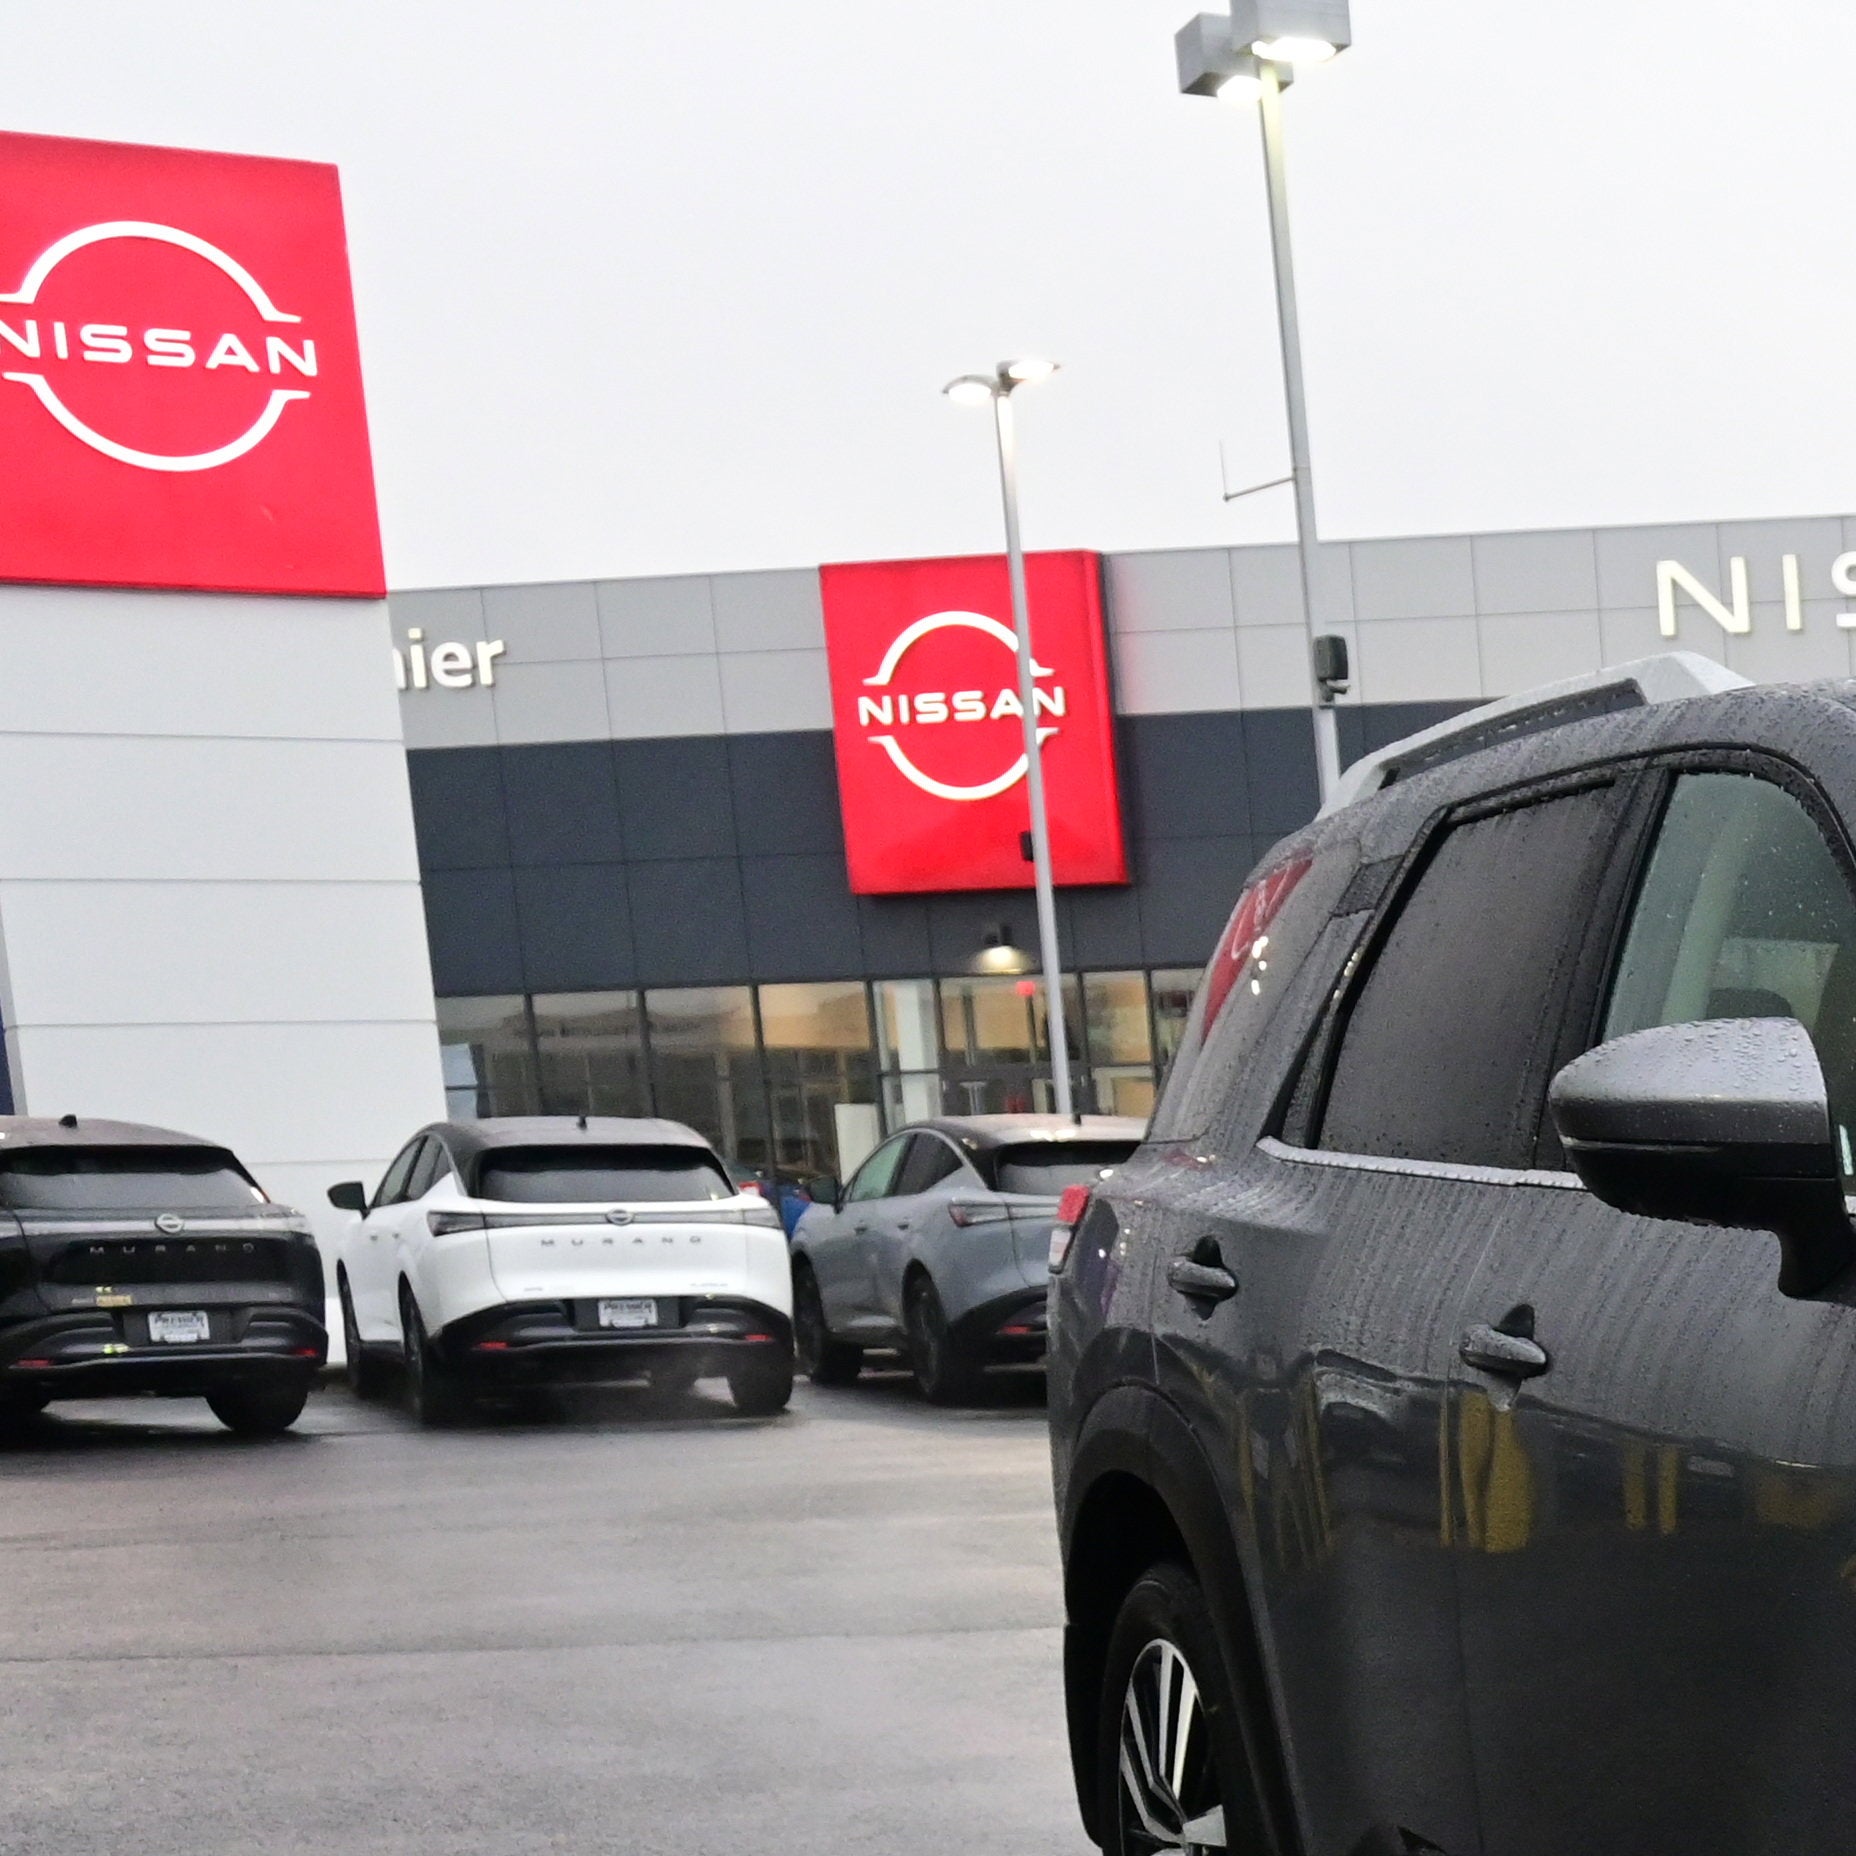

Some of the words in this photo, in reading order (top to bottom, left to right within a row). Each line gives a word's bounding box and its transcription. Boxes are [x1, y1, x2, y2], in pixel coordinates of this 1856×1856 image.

[0, 319, 318, 377] NISSAN
[858, 686, 1066, 726] NISSAN
[89, 1242, 255, 1254] MURANO
[541, 1235, 702, 1246] MURANO
